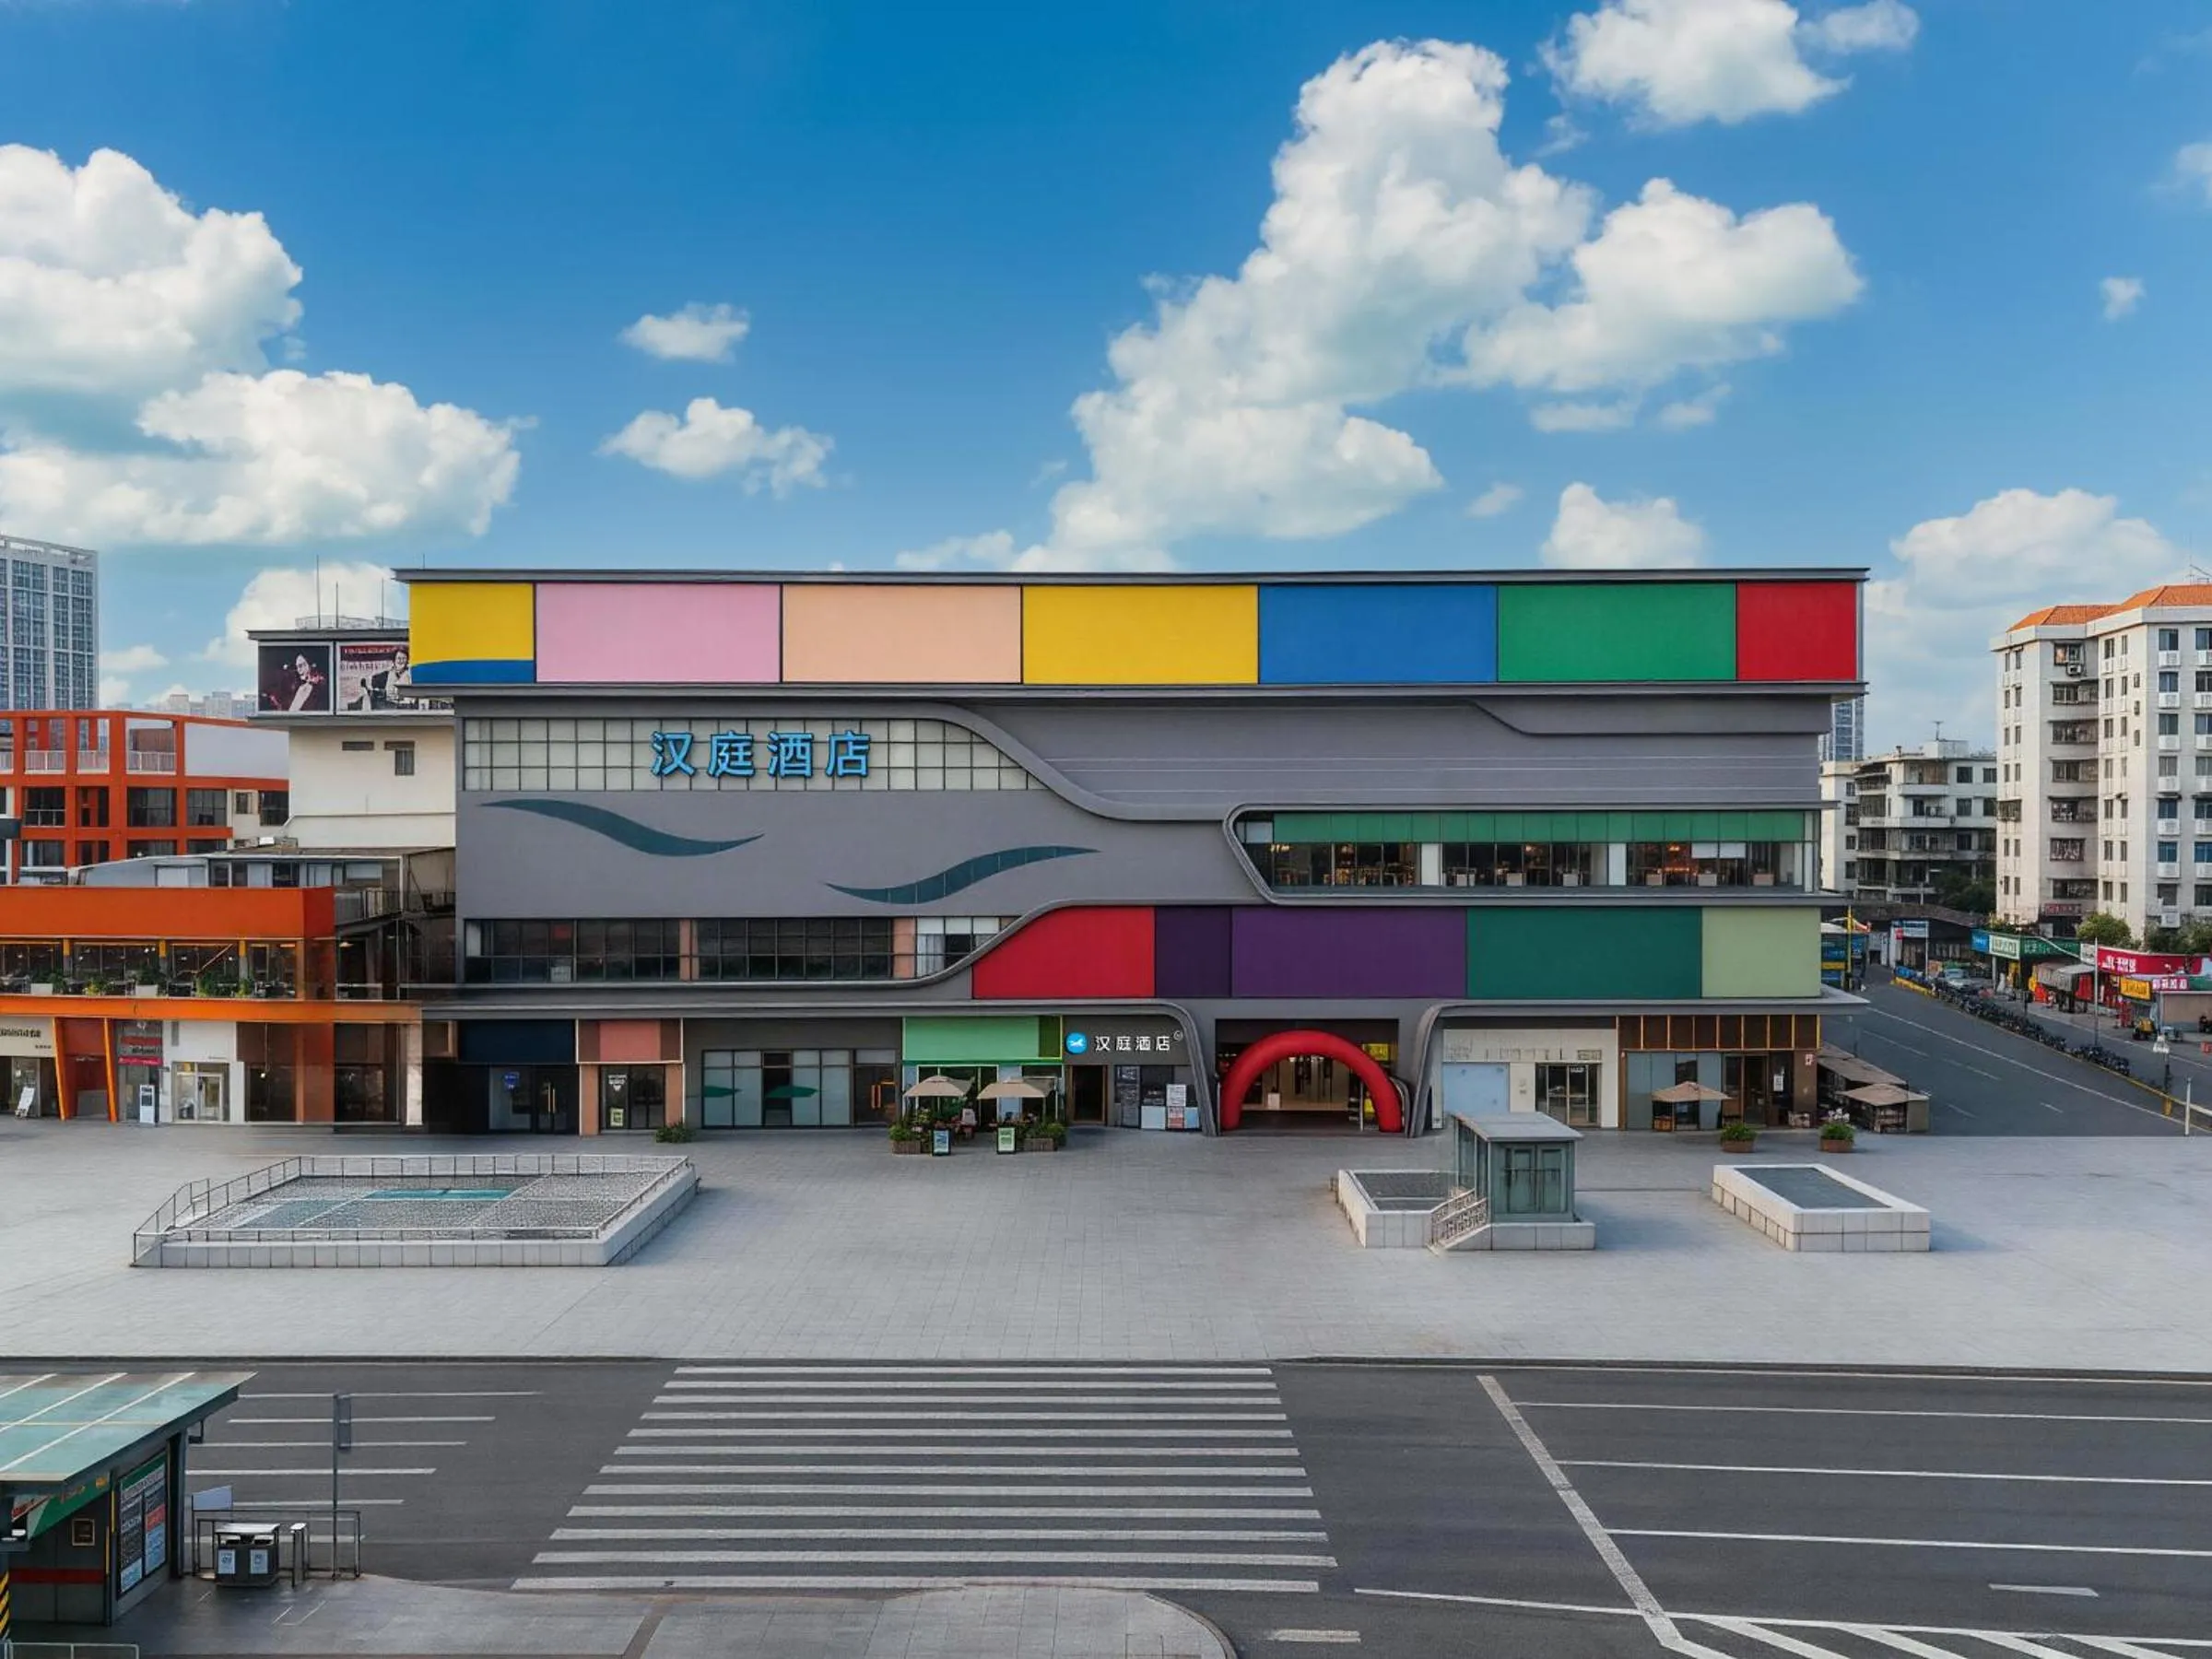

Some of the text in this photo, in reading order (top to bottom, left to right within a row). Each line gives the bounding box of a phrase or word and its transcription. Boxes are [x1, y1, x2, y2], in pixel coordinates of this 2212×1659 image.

[651, 730, 871, 778] 汉庭酒店
[1095, 1035, 1171, 1052] 汉庭酒店
